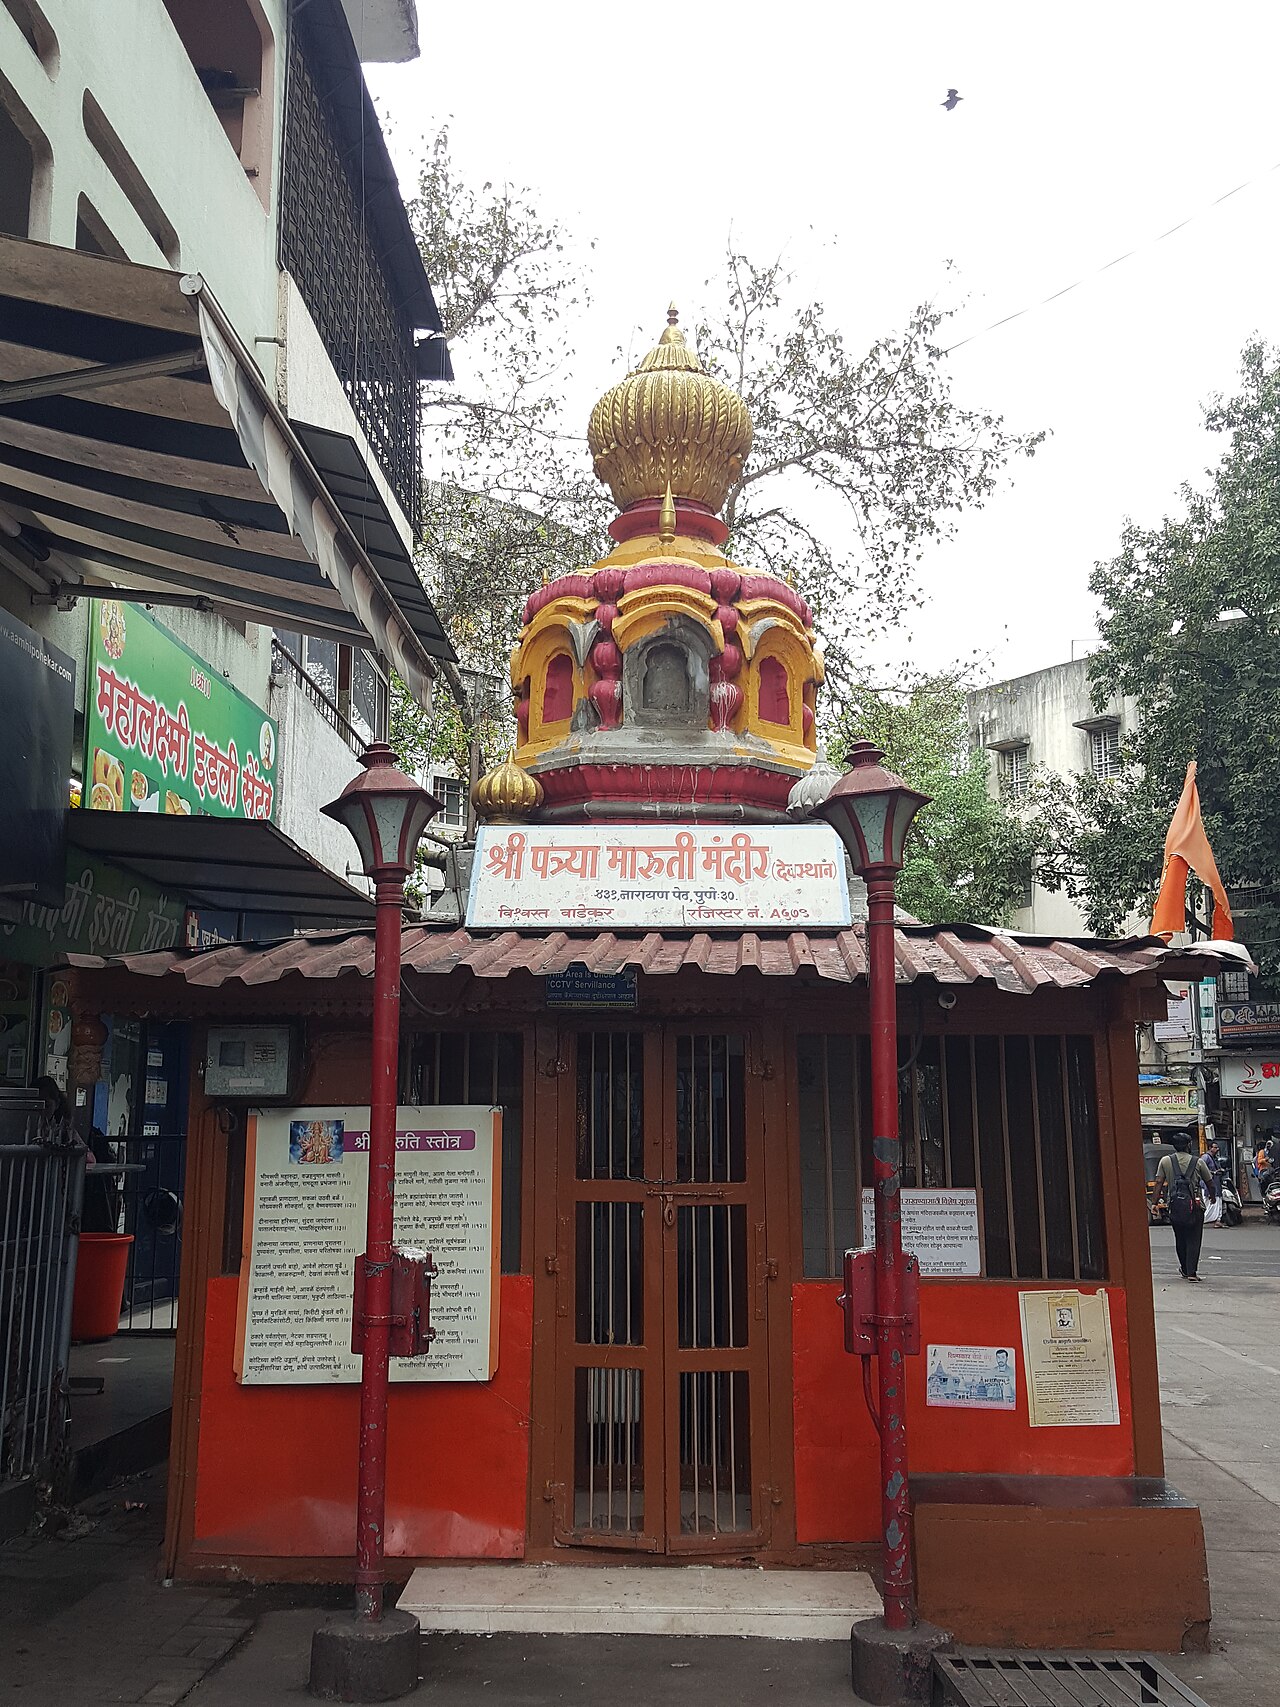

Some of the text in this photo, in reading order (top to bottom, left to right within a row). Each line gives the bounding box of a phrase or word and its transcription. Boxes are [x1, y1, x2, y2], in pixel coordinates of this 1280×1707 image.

[97, 667, 190, 778] महालक्ष्मी
[194, 735, 239, 808] इडली
[485, 832, 526, 880] श्री
[606, 832, 696, 881] मारुती
[702, 835, 771, 884] मंदीर
[498, 905, 550, 920] विश्वस्त
[560, 904, 615, 920] वाडेकर
[687, 906, 743, 920] रजिस्टर
[426, 1131, 461, 1149] स्तोत्र
